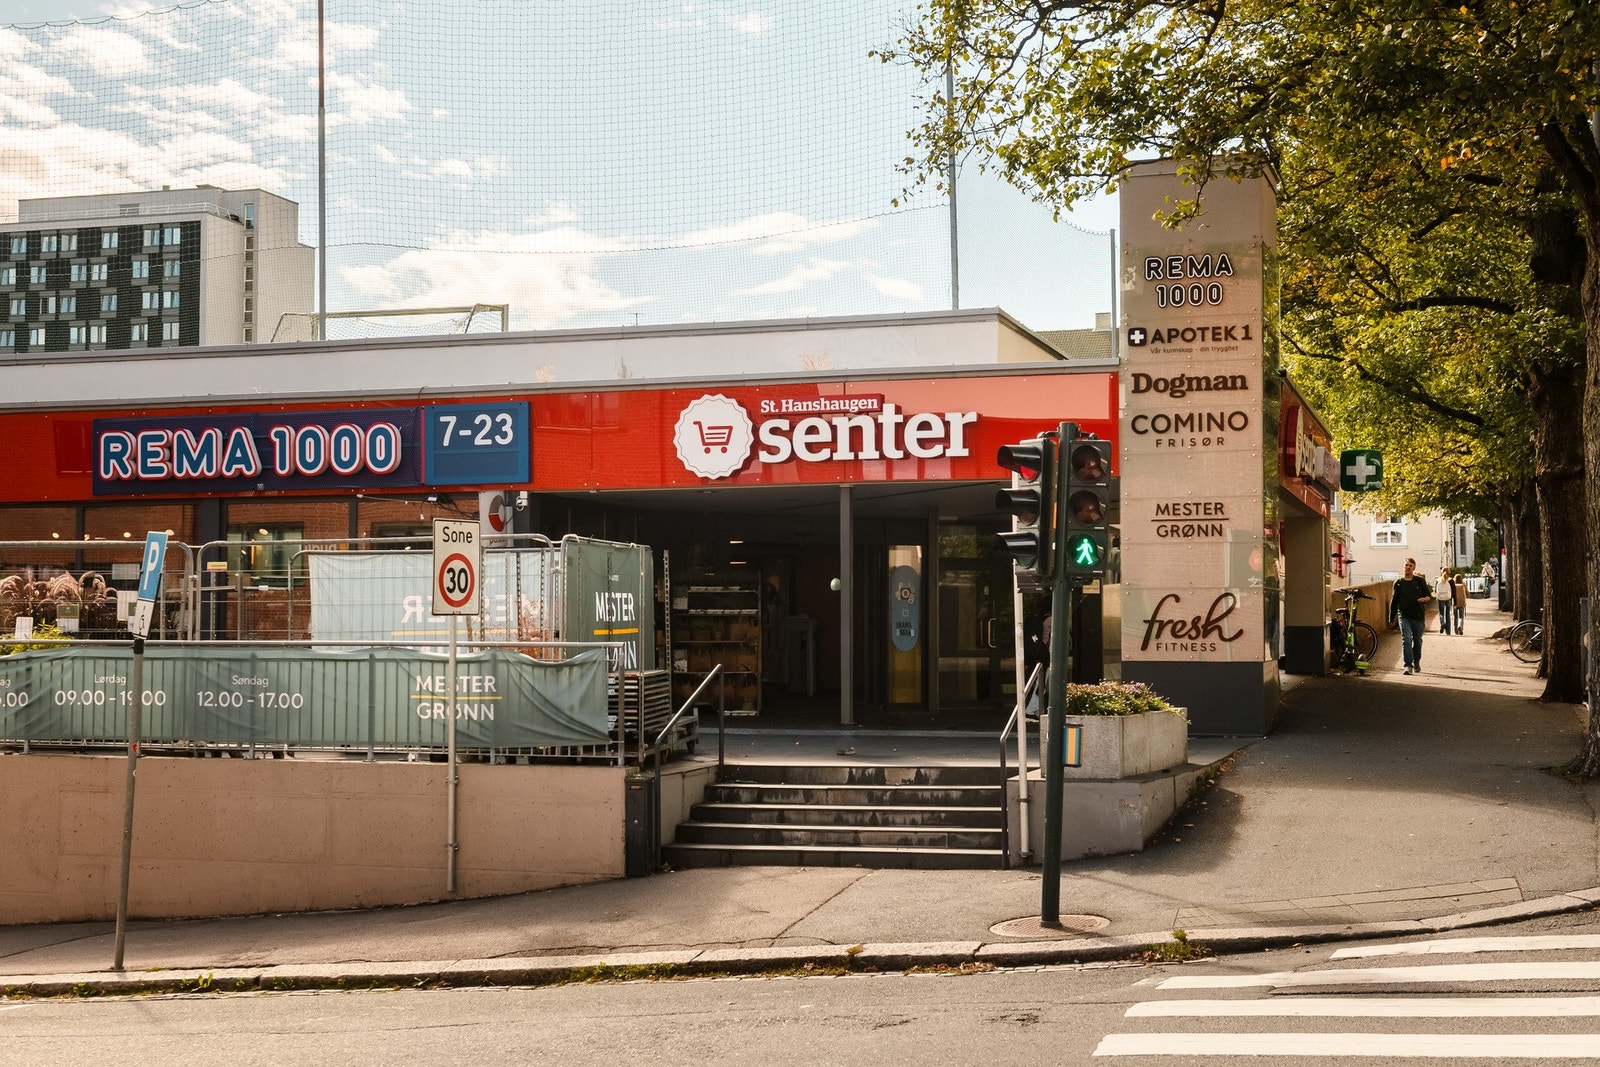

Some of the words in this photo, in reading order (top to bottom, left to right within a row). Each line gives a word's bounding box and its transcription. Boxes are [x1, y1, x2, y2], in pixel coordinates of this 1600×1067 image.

[1145, 254, 1234, 281] REMA
[1156, 282, 1223, 308] 1000
[1151, 325, 1239, 344] APOTEK
[1241, 324, 1252, 340] 1
[1131, 373, 1248, 398] Dogman
[760, 400, 779, 413] St.
[781, 398, 878, 413] Hanshaugen
[439, 412, 514, 447] 7-23
[1131, 411, 1249, 435] COMINO
[758, 403, 977, 463] senter
[1156, 437, 1225, 448] FRISØR
[100, 426, 262, 481] REMA
[268, 421, 402, 478] 1000
[1155, 502, 1225, 517] MESTER
[442, 526, 473, 543] Sone
[1156, 523, 1223, 538] GRØNN
[143, 541, 159, 590] P
[446, 567, 469, 593] 30
[1140, 592, 1244, 651] fresh
[1156, 642, 1217, 652] FITNESS
[94, 675, 127, 686] Lørdag
[232, 675, 269, 687] Søndag
[0, 692, 29, 707] .00
[54, 690, 105, 706] 09.00
[197, 691, 244, 708] 12.00
[258, 692, 304, 709] 17.00
